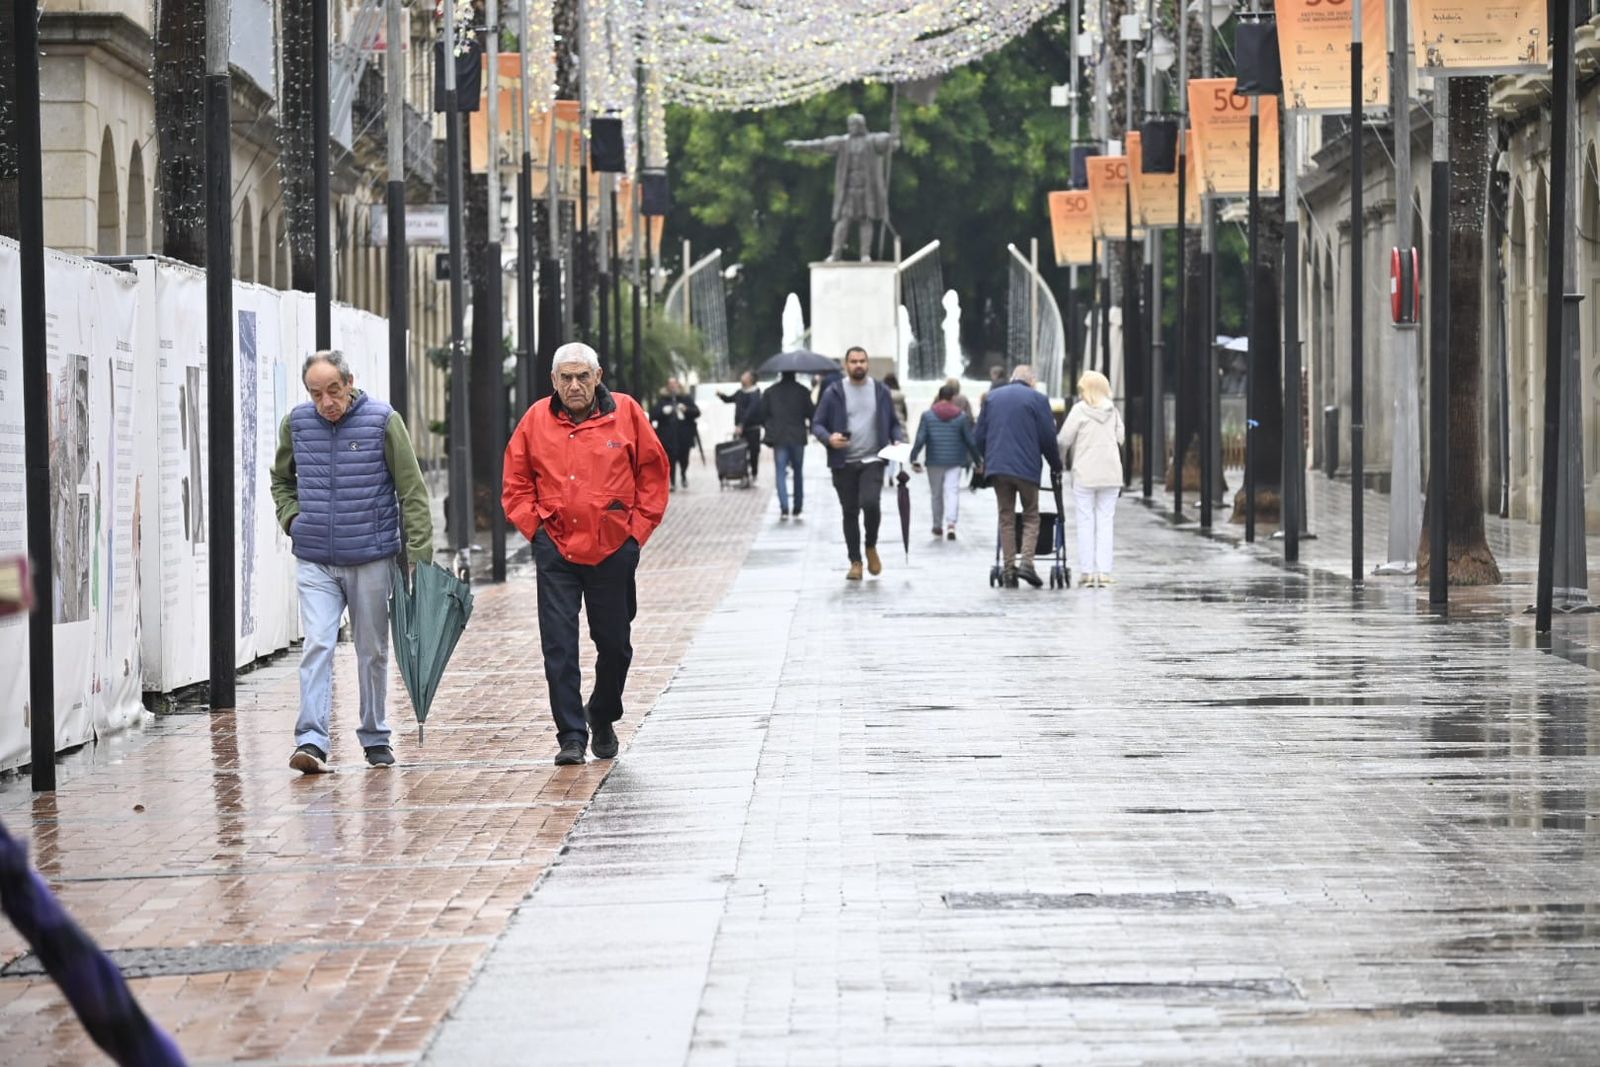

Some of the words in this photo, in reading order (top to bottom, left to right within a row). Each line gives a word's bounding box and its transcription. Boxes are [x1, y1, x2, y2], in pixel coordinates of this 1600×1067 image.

[1214, 88, 1248, 112] 50
[1105, 162, 1128, 180] 50
[1065, 197, 1088, 212] 50
